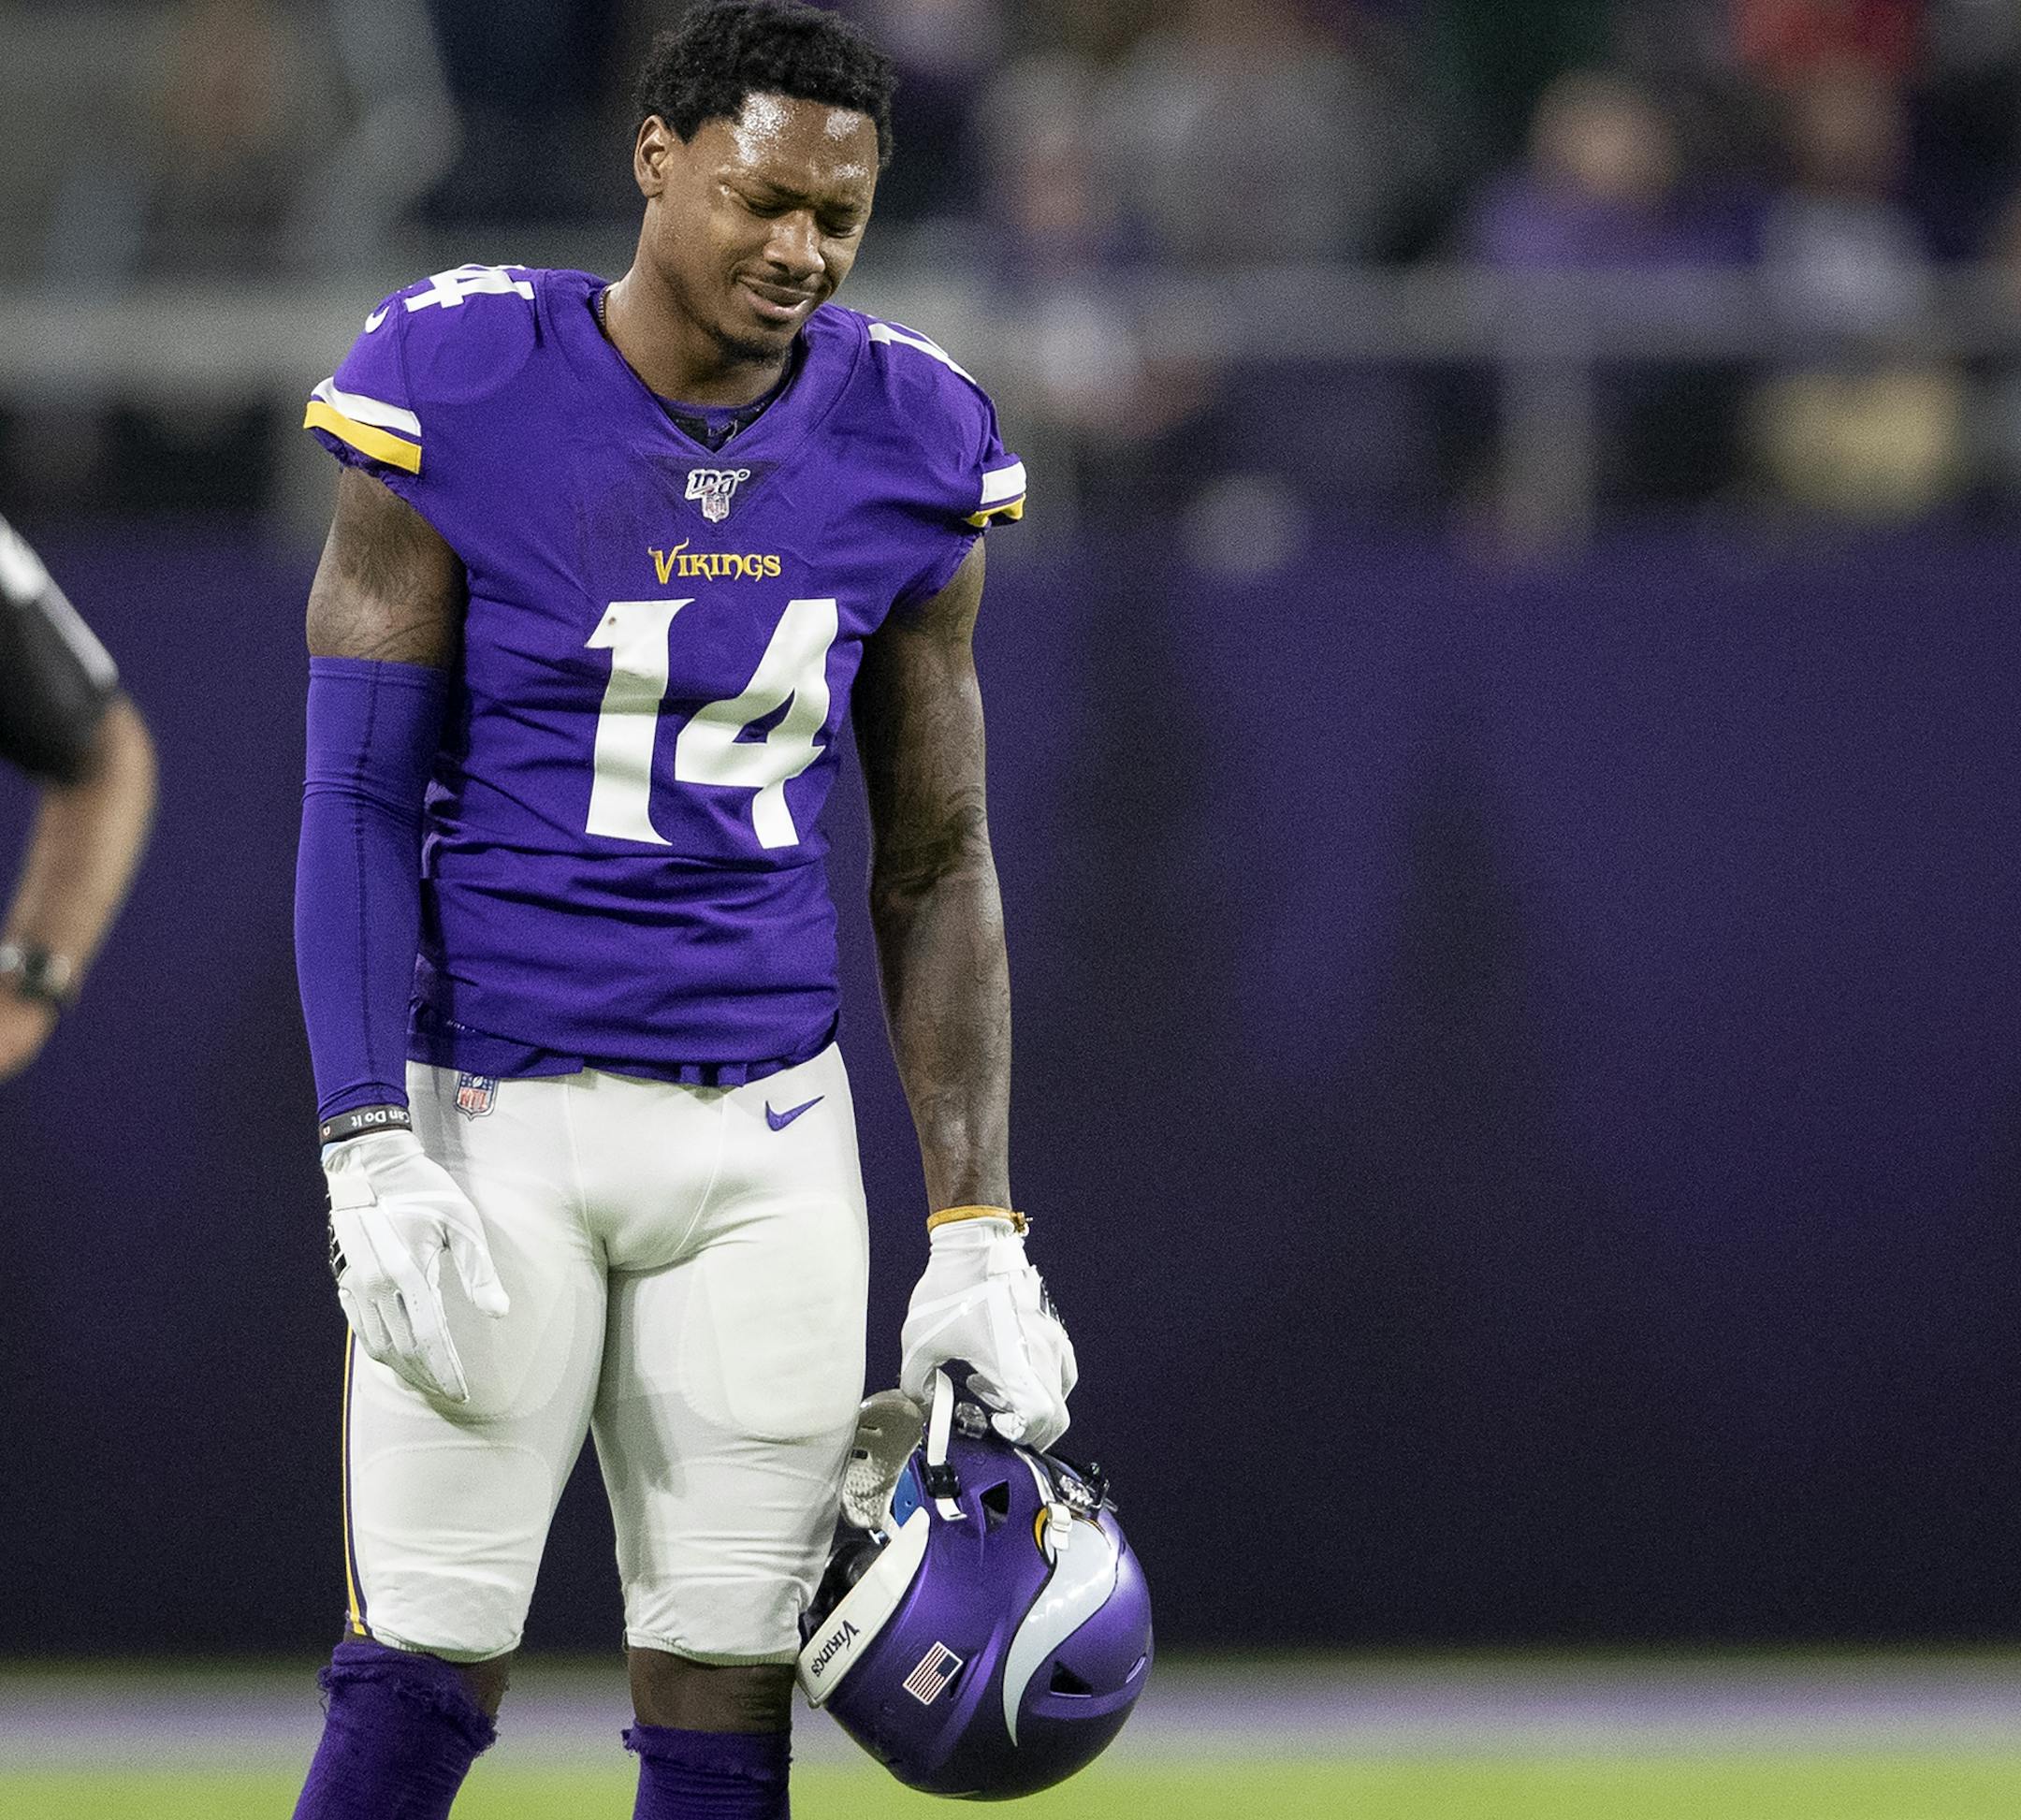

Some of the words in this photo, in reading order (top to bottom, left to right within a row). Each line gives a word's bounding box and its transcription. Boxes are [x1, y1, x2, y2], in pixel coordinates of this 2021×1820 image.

[403, 263, 536, 313] 4
[583, 597, 839, 850] 14
[351, 1114, 363, 1128] It
[364, 1110, 387, 1124] Do
